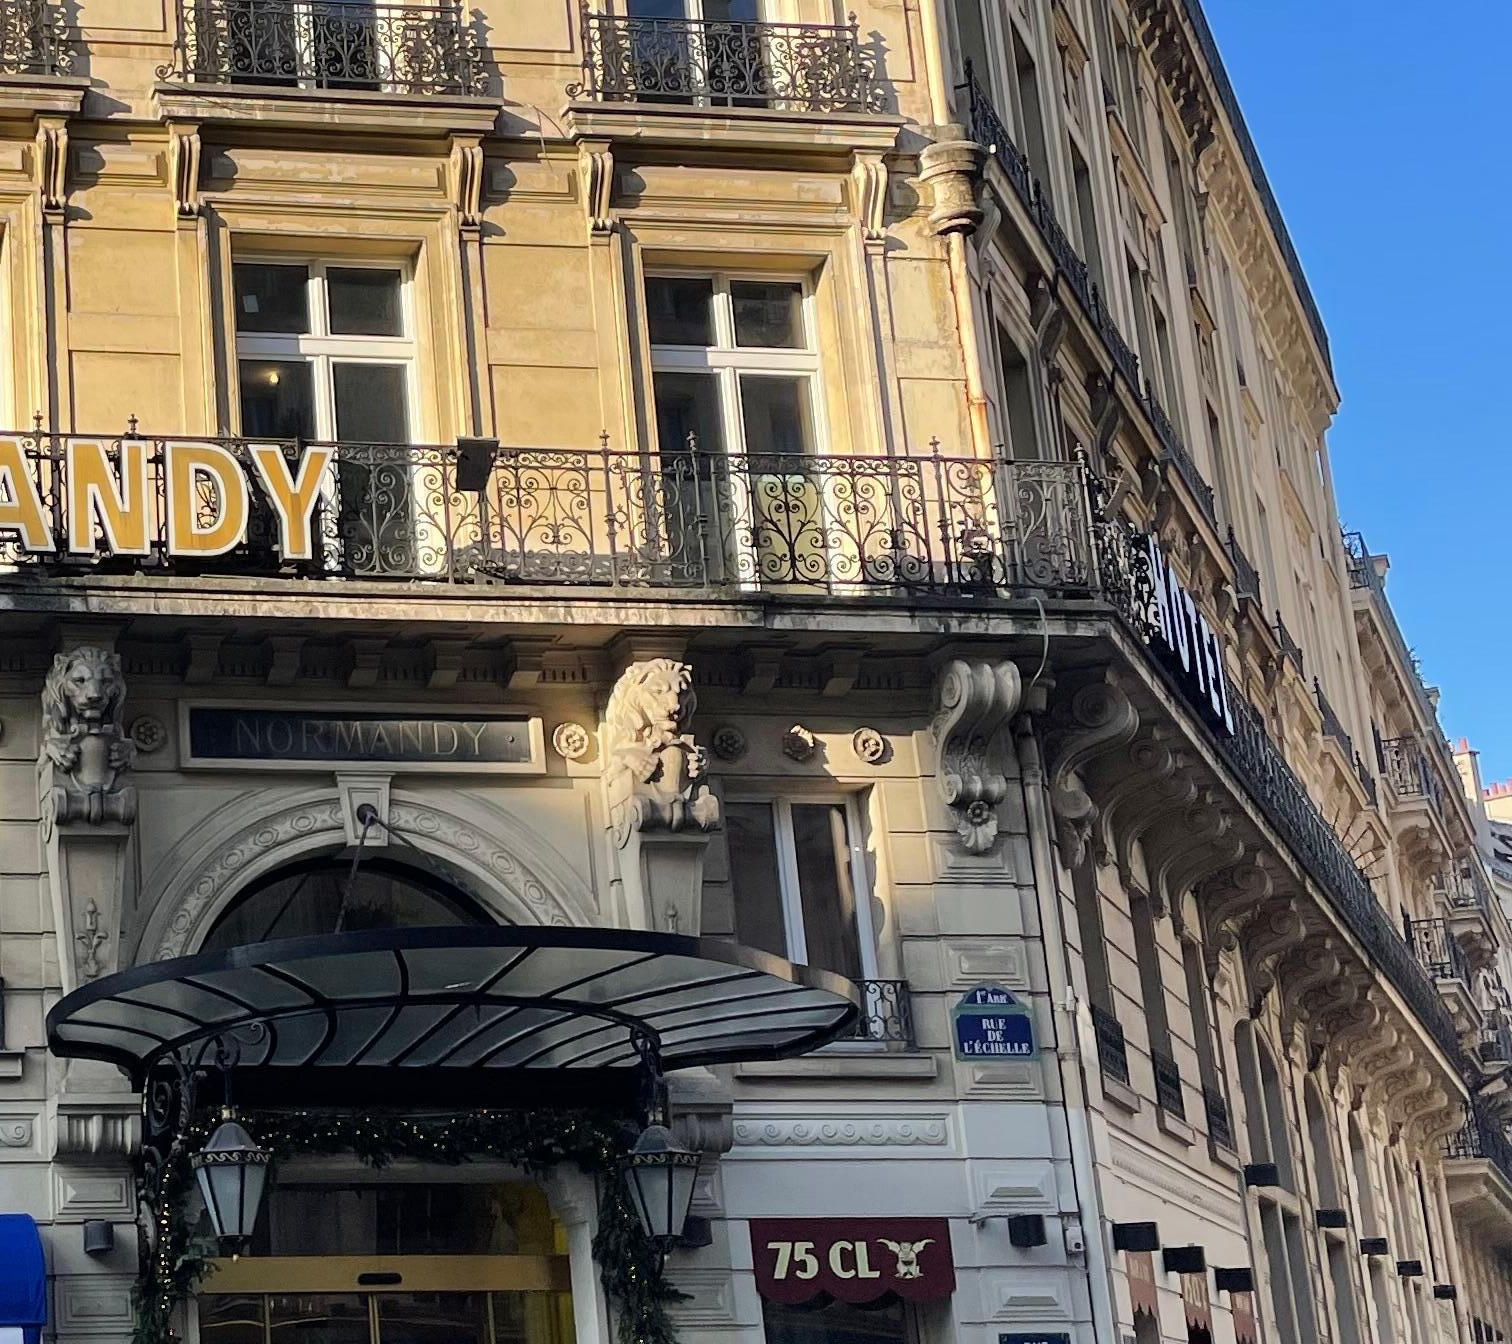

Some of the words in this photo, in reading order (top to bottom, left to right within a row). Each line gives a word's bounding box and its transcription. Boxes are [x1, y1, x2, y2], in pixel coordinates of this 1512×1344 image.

[235, 719, 489, 756] NORMANDY
[981, 1018, 1007, 1030] RUE
[987, 1030, 1004, 1042] DE
[767, 1241, 819, 1280] 75
[828, 1240, 881, 1279] CL
